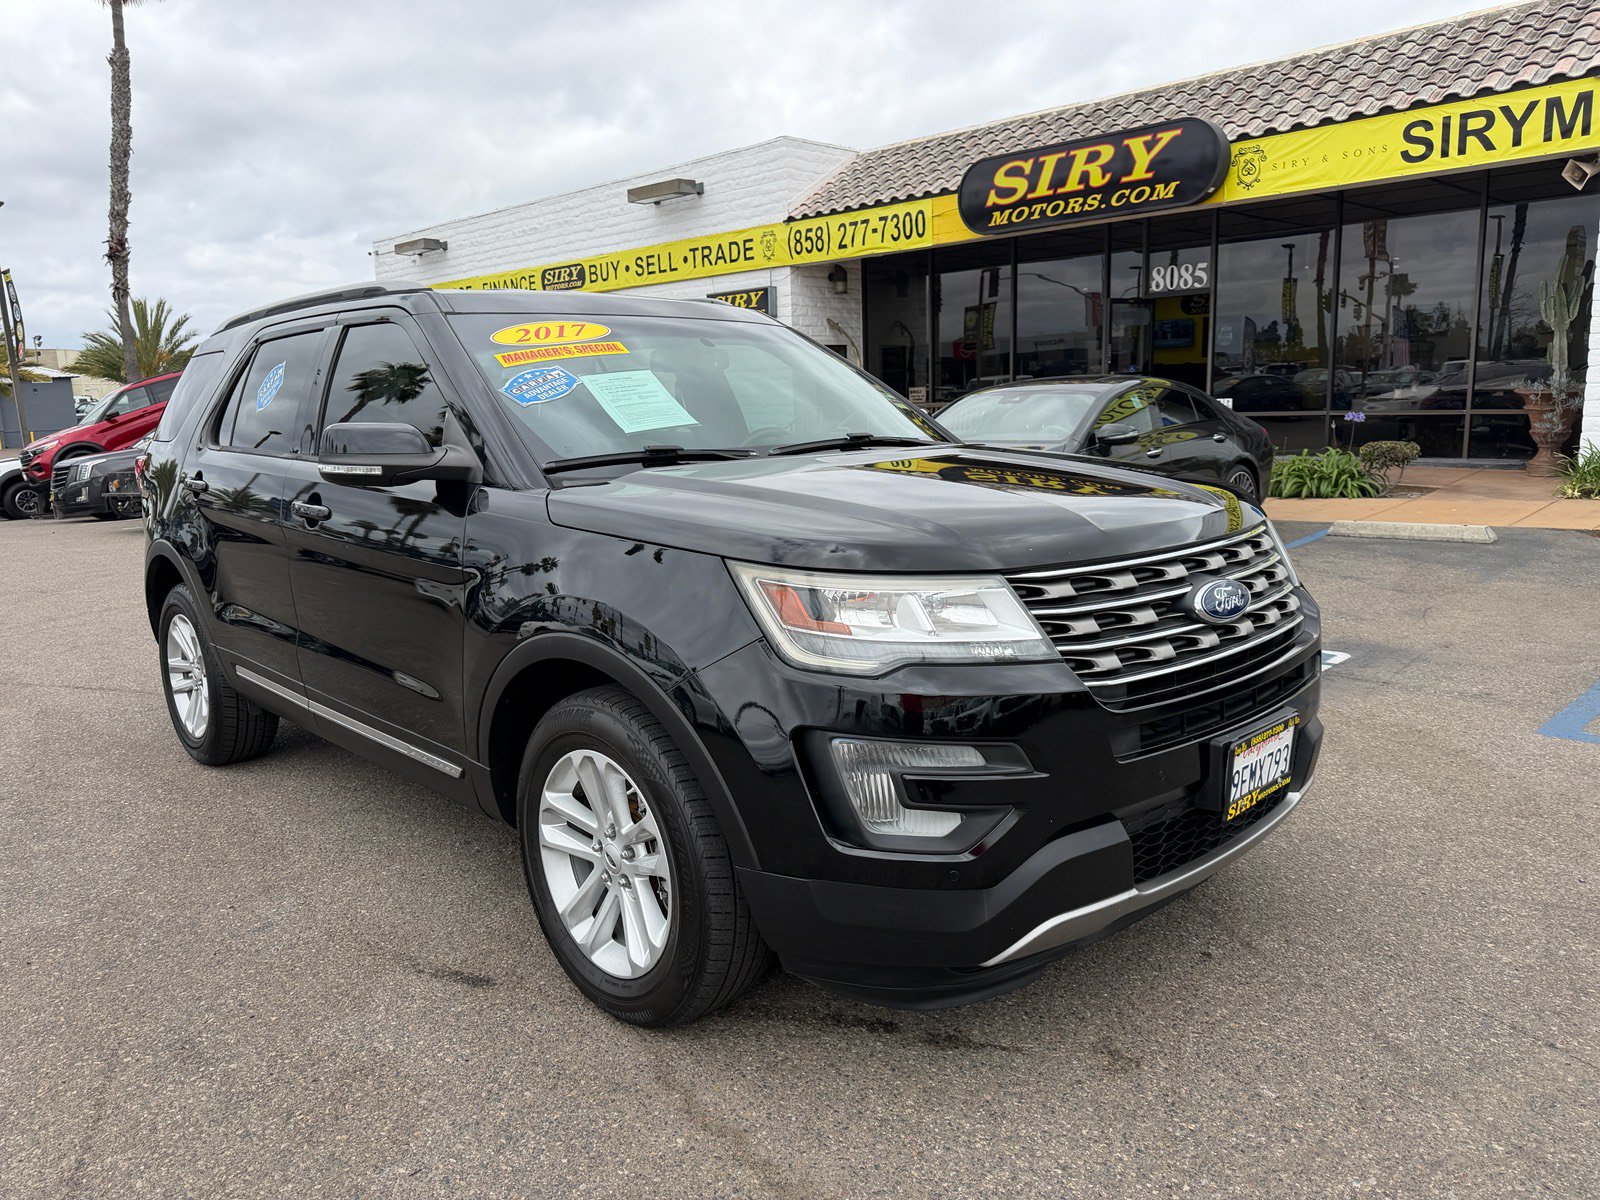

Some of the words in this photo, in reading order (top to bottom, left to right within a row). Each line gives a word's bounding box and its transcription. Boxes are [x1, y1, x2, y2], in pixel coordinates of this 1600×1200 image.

[1400, 90, 1594, 164] SIRYM
[985, 128, 1183, 208] SIRY
[1272, 157, 1310, 171] SIRY
[1321, 154, 1329, 163] &
[1342, 144, 1388, 160] SONS
[987, 181, 1181, 227] MOTORS.COM
[787, 221, 831, 260] (858)
[837, 209, 926, 250] 277-7300
[588, 260, 620, 283] BUY
[635, 252, 678, 277] SELL
[689, 238, 755, 268] TRADE
[545, 265, 583, 285] SIRY
[1151, 262, 1208, 291] 8085
[515, 324, 587, 343] 2017
[501, 346, 575, 364] MANAGER'S
[574, 342, 622, 355] SPECIAL
[510, 370, 566, 395] CARFAX
[523, 377, 569, 399] ADVANTAGE
[537, 385, 569, 400] DEALER
[1213, 586, 1244, 612] Ford
[1227, 788, 1260, 821] SIRY
